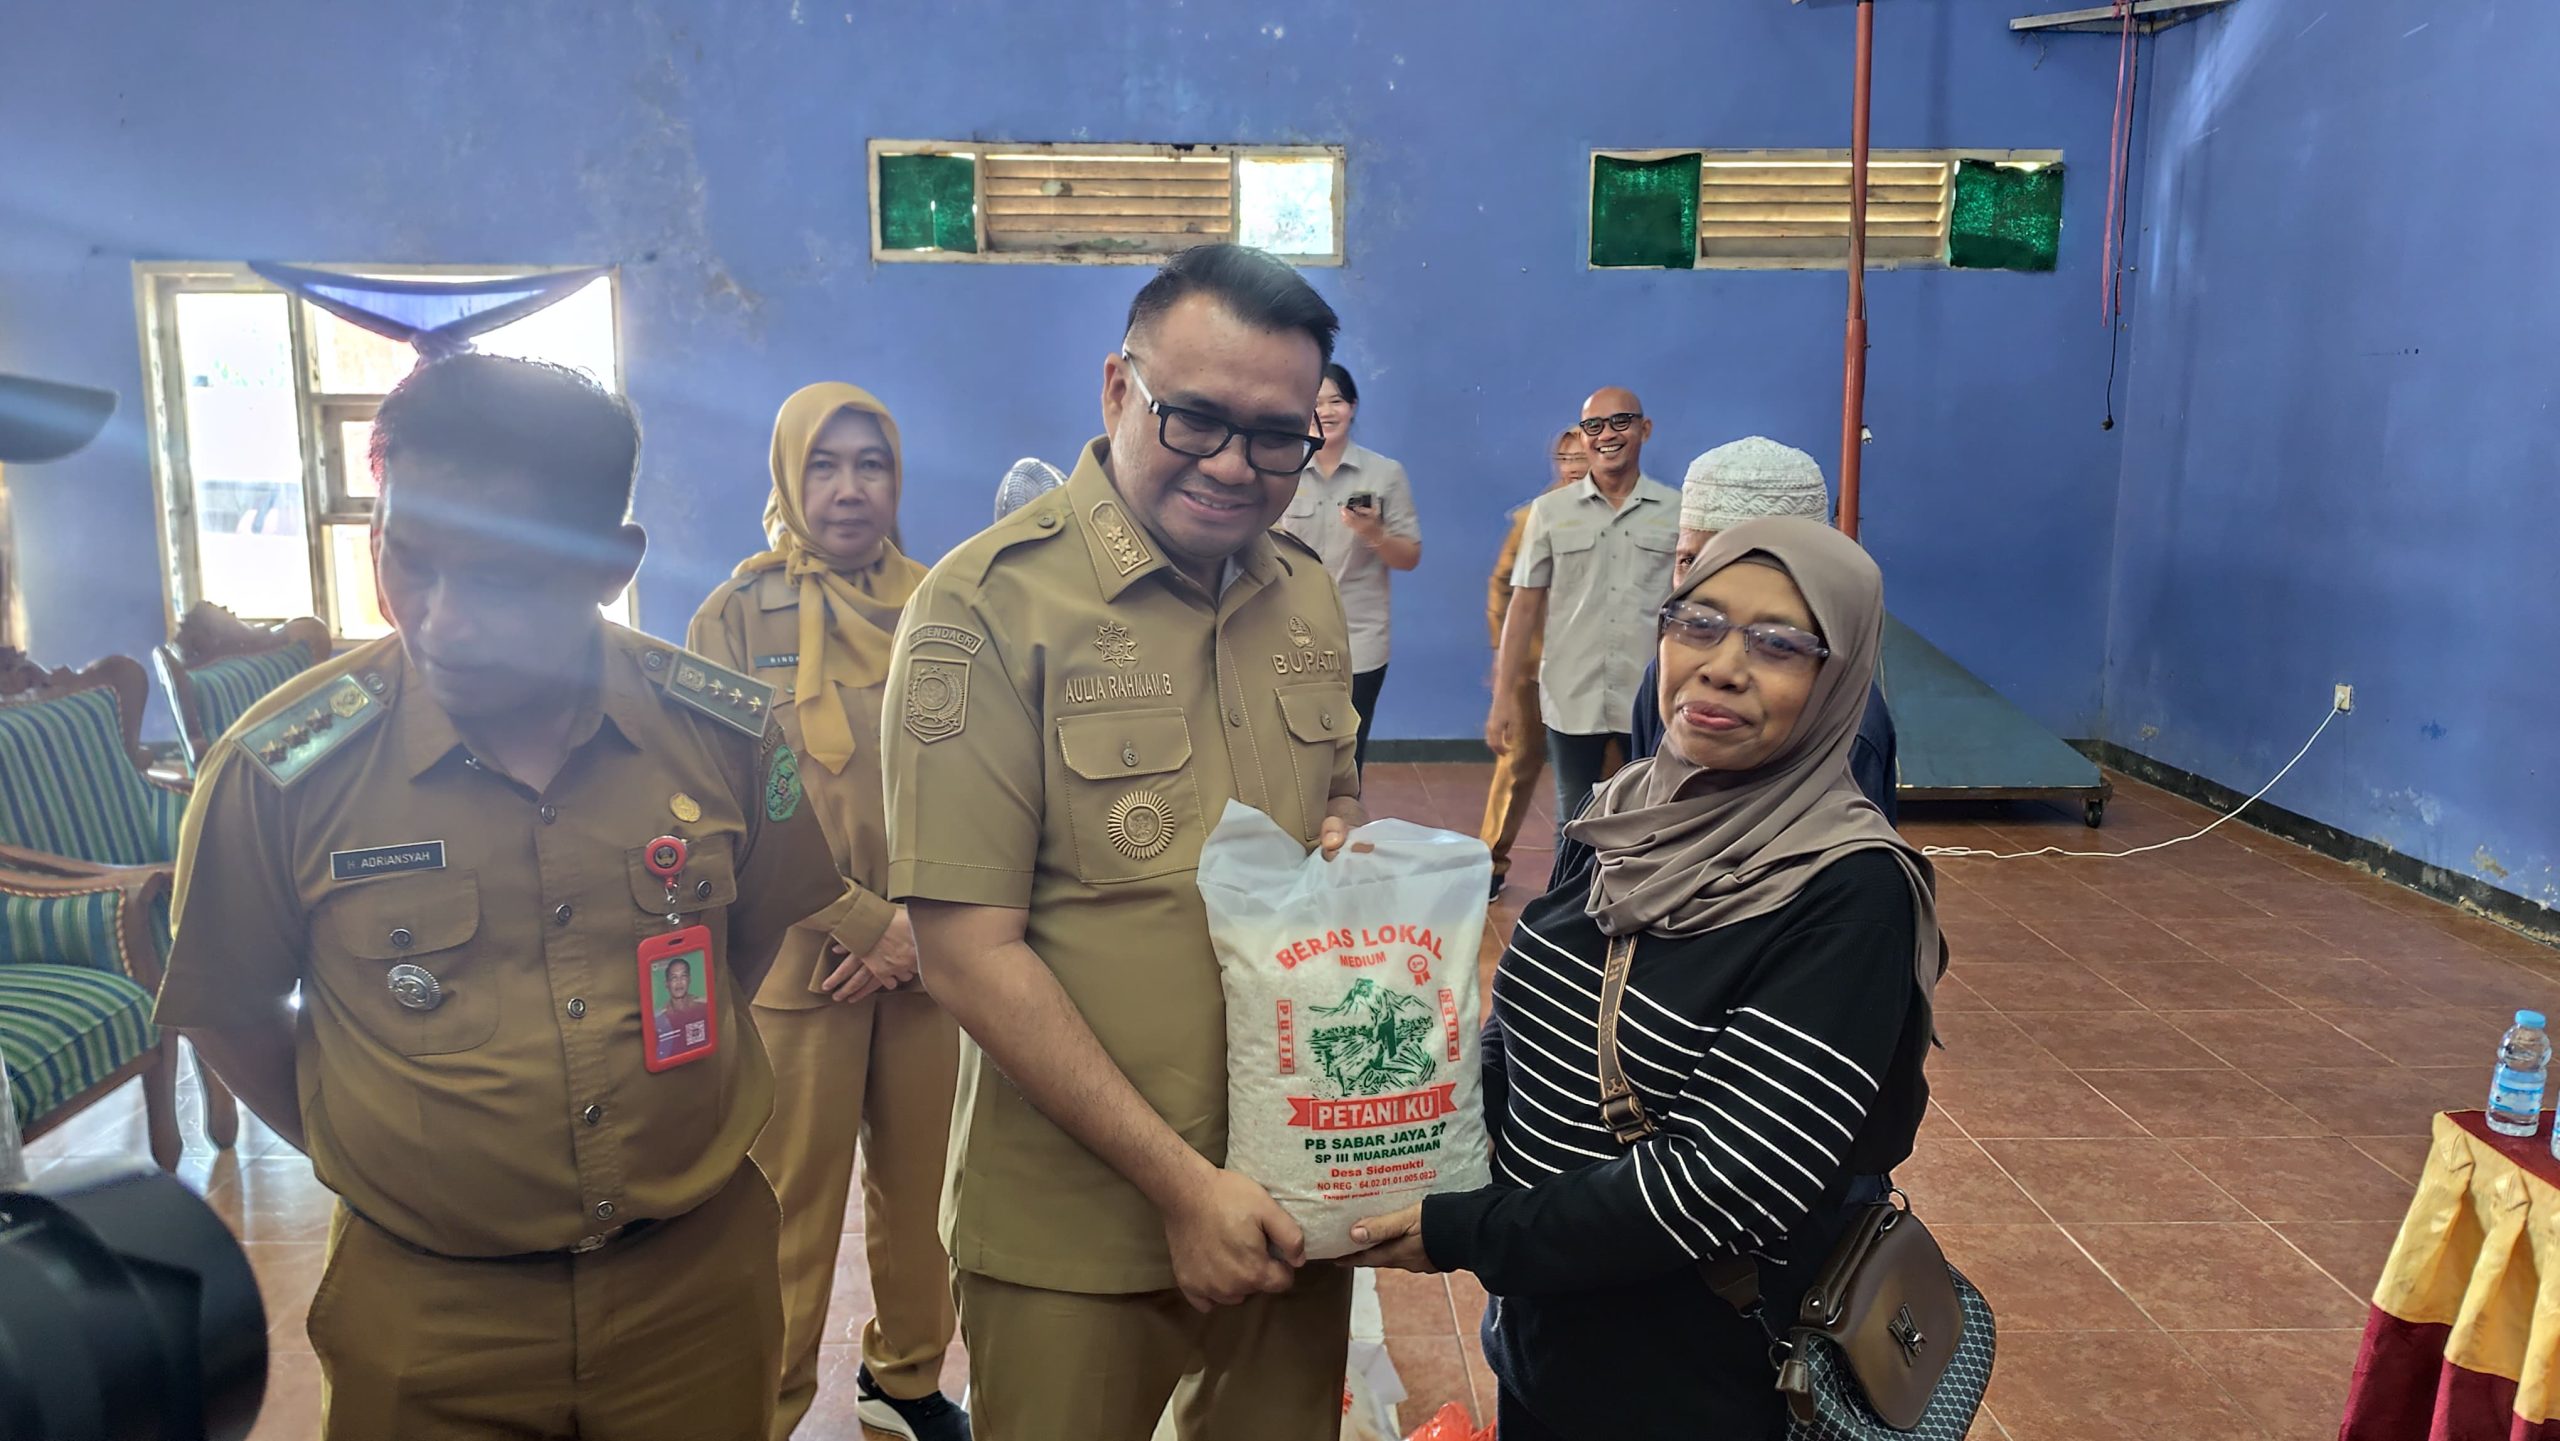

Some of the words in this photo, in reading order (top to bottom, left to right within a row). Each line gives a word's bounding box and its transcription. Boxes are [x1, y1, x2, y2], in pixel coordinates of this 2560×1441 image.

[1271, 650, 1342, 675] BUPATI
[1064, 675, 1107, 704] AULIA
[361, 852, 430, 868] ADRIANSYAH
[1276, 928, 1355, 970] BERAS
[1361, 924, 1442, 961] LOKAL
[1339, 951, 1387, 968] MEDIUM
[1279, 1004, 1292, 1068] PUTIH
[1318, 1100, 1399, 1128] PETANI
[1404, 1095, 1434, 1120] KU
[1304, 1138, 1327, 1150] PB
[1331, 1134, 1386, 1150] SABAR
[1390, 1128, 1427, 1144] JAYA
[1314, 1154, 1332, 1164] SP
[1335, 1153, 1349, 1163] III
[1353, 1139, 1441, 1162] MUARAKAMAN
[1331, 1168, 1362, 1178] Desa
[1366, 1159, 1424, 1175] Sidomukti
[1333, 1182, 1352, 1190] REG
